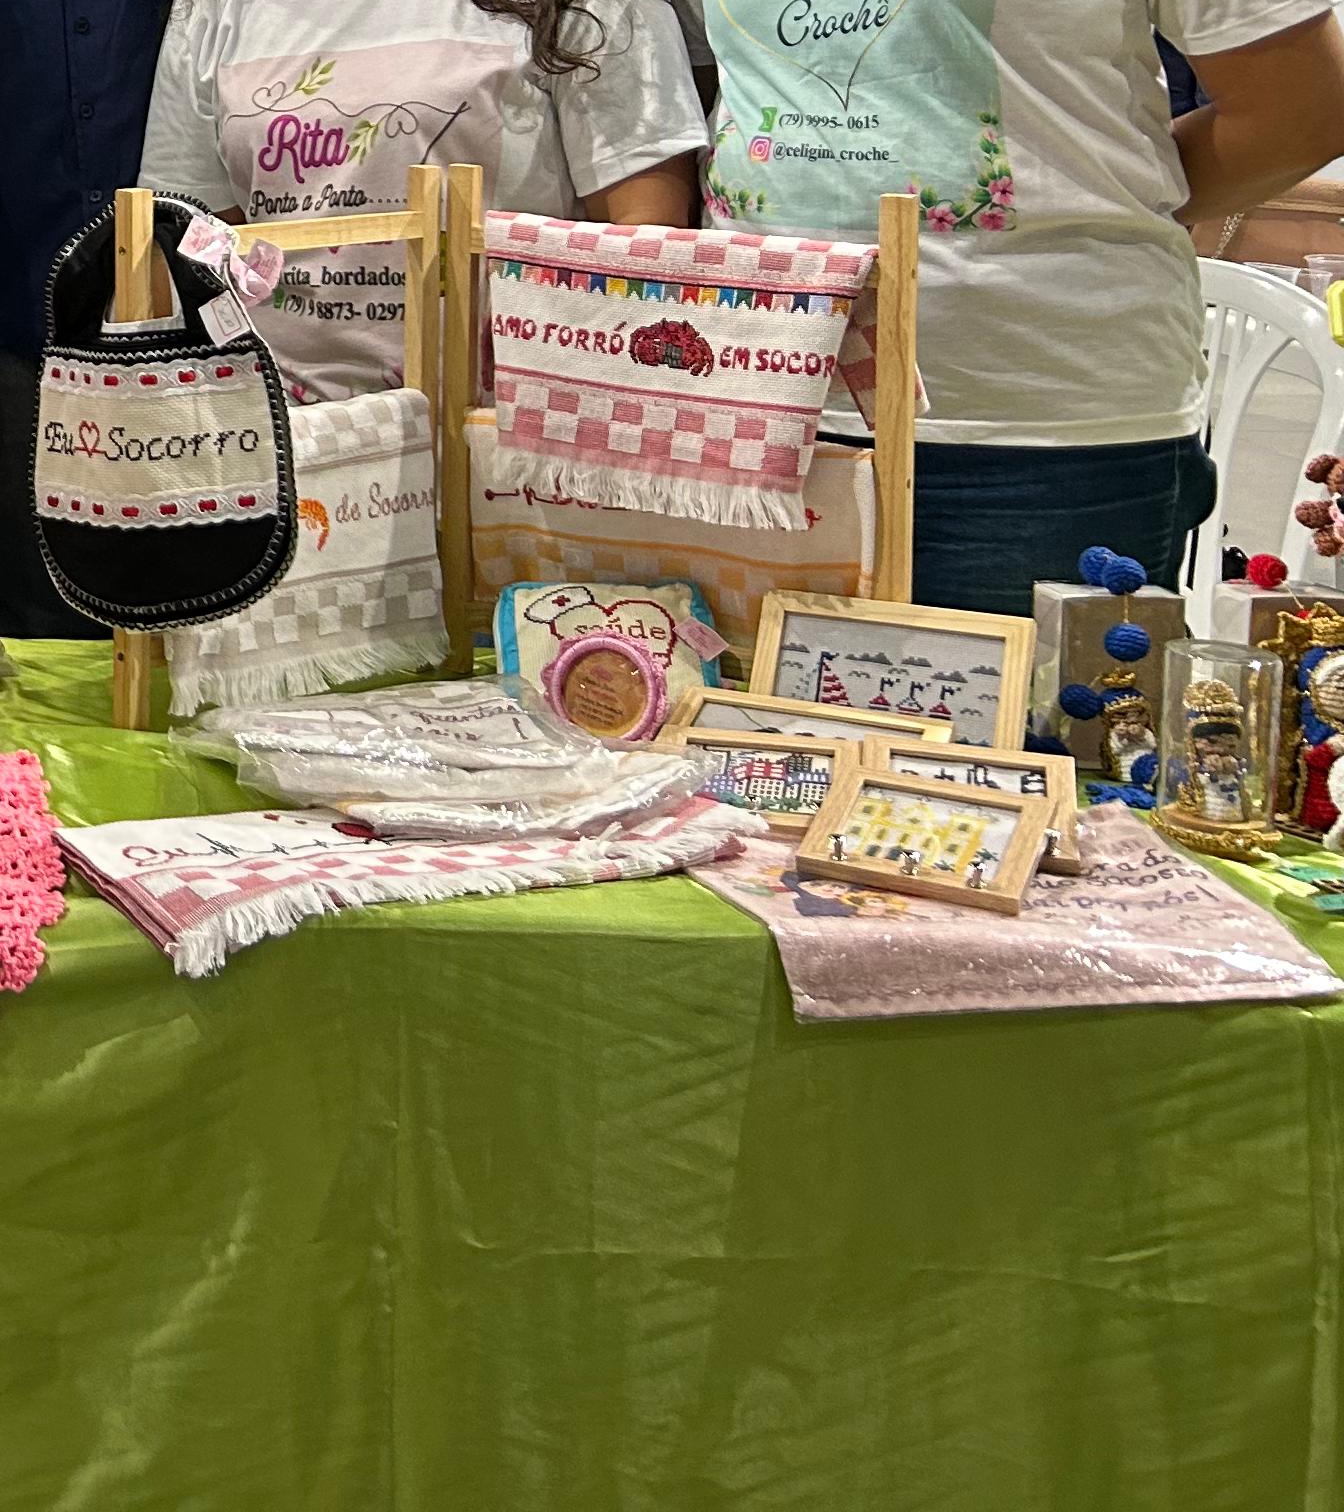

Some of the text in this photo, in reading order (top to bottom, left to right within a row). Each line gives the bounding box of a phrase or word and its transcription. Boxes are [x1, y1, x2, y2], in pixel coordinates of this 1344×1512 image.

[847, 114, 880, 130] 0615
[258, 114, 350, 184] Rita
[250, 190, 299, 217] Ponto
[366, 302, 405, 321] 0297
[493, 313, 537, 341] AMO
[542, 320, 628, 356] FORRÓ
[719, 344, 751, 370] EM
[44, 421, 260, 462] Eu Socorro
[335, 492, 362, 524] de
